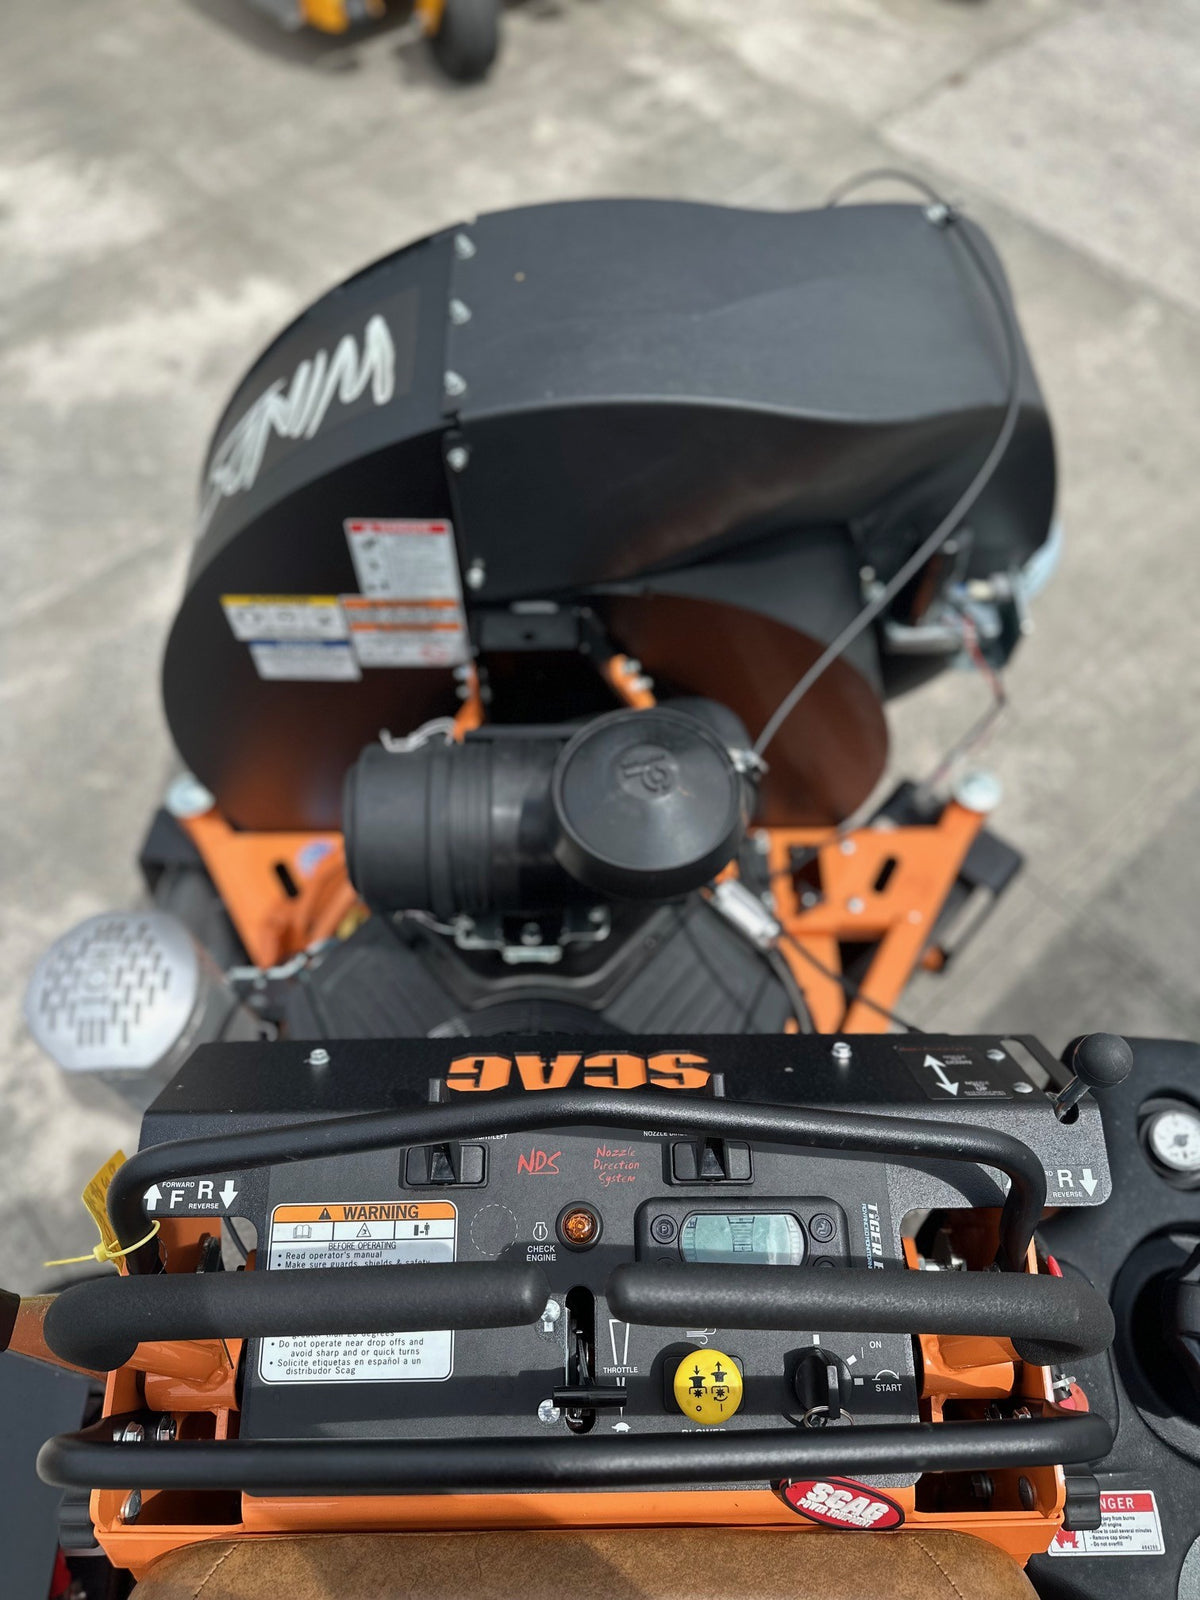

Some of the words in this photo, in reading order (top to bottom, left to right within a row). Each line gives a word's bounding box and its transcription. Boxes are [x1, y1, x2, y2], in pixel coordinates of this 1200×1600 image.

[446, 1051, 710, 1091] SCAG
[596, 1144, 636, 1158] Nozzle
[517, 1147, 562, 1175] NDS
[593, 1158, 640, 1170] Direction
[598, 1172, 636, 1187] System
[1056, 1170, 1074, 1188] R
[197, 1180, 214, 1200] R
[169, 1190, 185, 1209] F
[343, 1205, 420, 1220] WARNING
[328, 1242, 355, 1250] BEFORE
[357, 1242, 397, 1250] OPERATING
[527, 1244, 556, 1253] CHECK
[865, 1236, 873, 1269] MONITORIN
[308, 1251, 351, 1260] operator's
[354, 1250, 382, 1259] manual
[526, 1254, 557, 1262] ENGINE
[278, 1340, 290, 1348] Do
[310, 1340, 342, 1348] operate
[366, 1339, 386, 1348] drop
[390, 1338, 406, 1346] offs
[409, 1338, 424, 1346] and
[869, 1340, 882, 1349] ON
[290, 1350, 312, 1358] avoid
[316, 1349, 340, 1358] sharp
[343, 1348, 358, 1356] and
[373, 1348, 395, 1356] quick
[398, 1348, 420, 1356] turns
[277, 1358, 309, 1366] Solicite
[312, 1358, 350, 1368] etiquetas
[368, 1357, 400, 1367] español
[286, 1367, 332, 1376] distribudor
[335, 1366, 356, 1376] Scag
[875, 1384, 902, 1392] START
[806, 1482, 890, 1520] SCAG
[1100, 1497, 1134, 1510] NGER
[796, 1498, 829, 1514] POWER
[826, 1506, 874, 1528] EQUIPMENT
